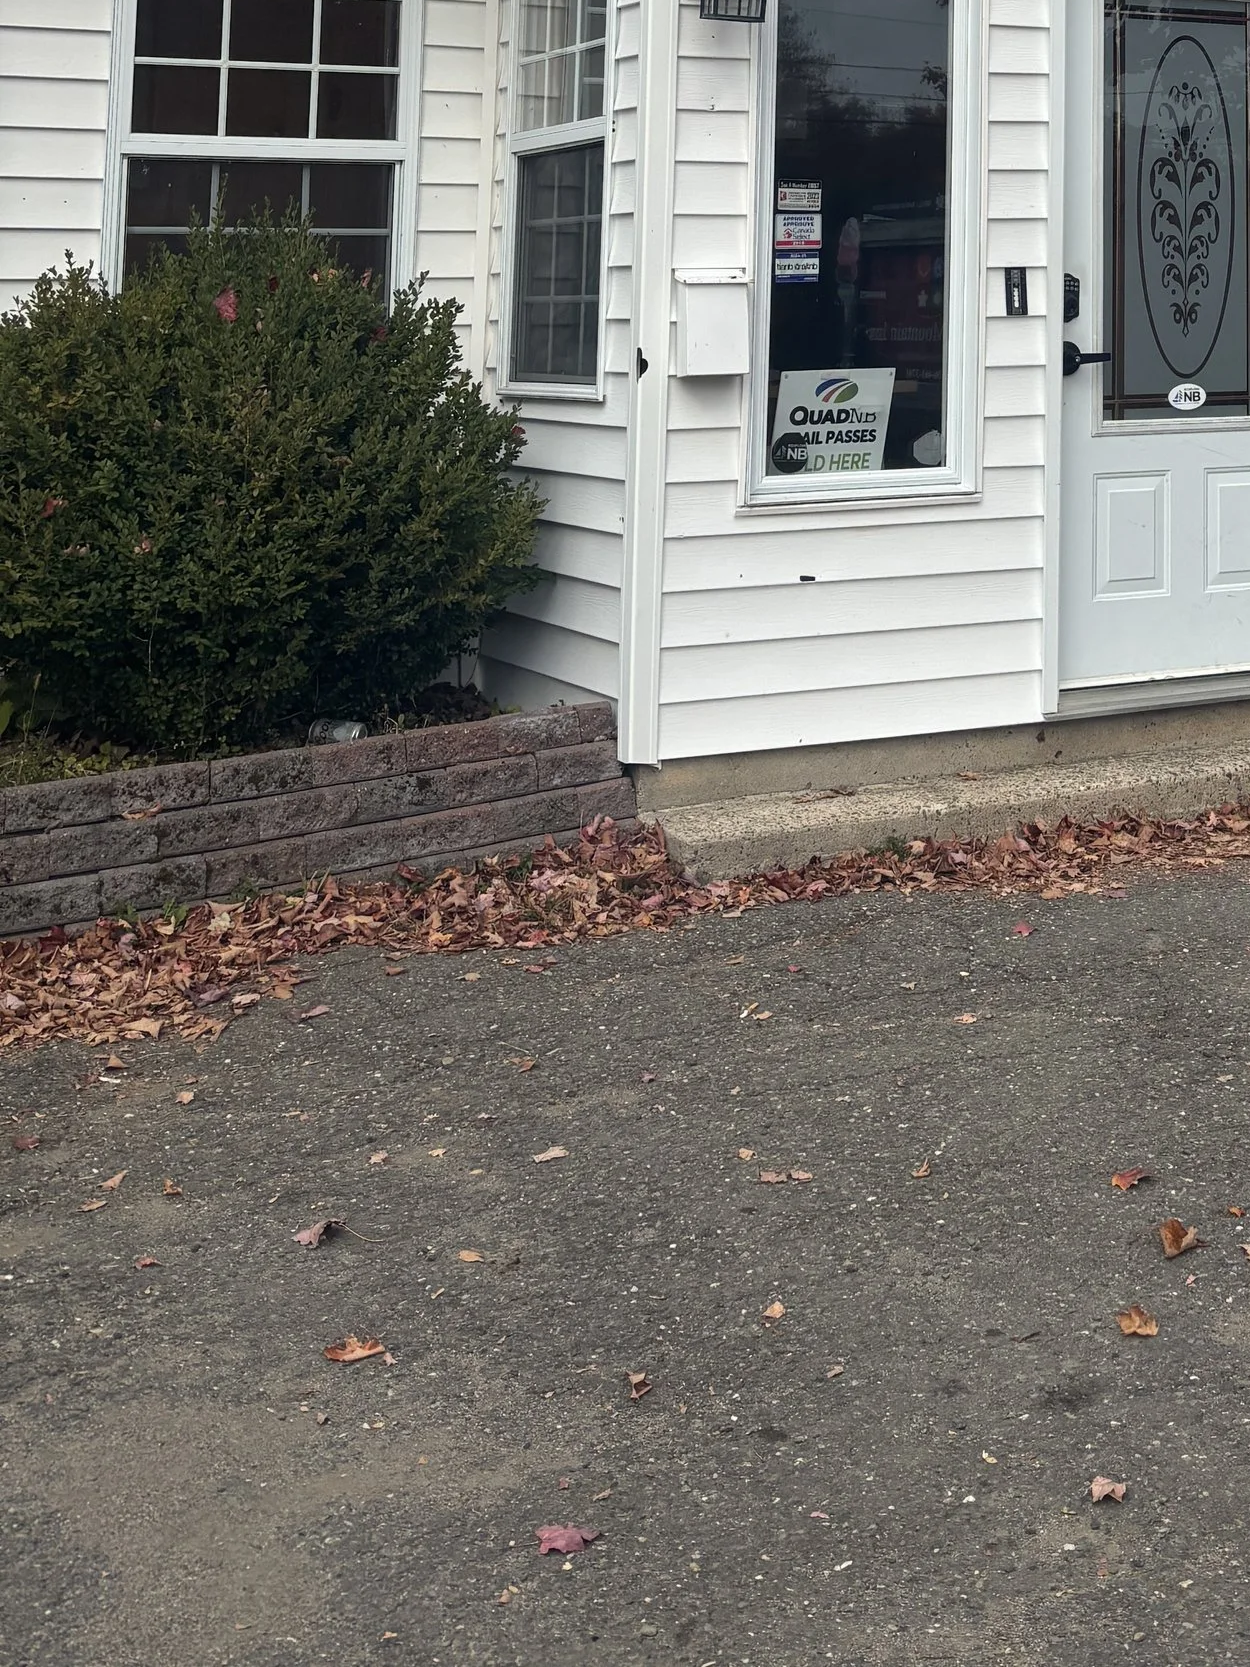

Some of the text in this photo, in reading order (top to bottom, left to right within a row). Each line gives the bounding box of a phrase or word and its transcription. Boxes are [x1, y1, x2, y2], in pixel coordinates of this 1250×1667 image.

[1183, 391, 1201, 402] NB
[802, 428, 877, 446] AIL PASSES
[786, 448, 808, 460] NB
[805, 452, 872, 472] LD HERE
